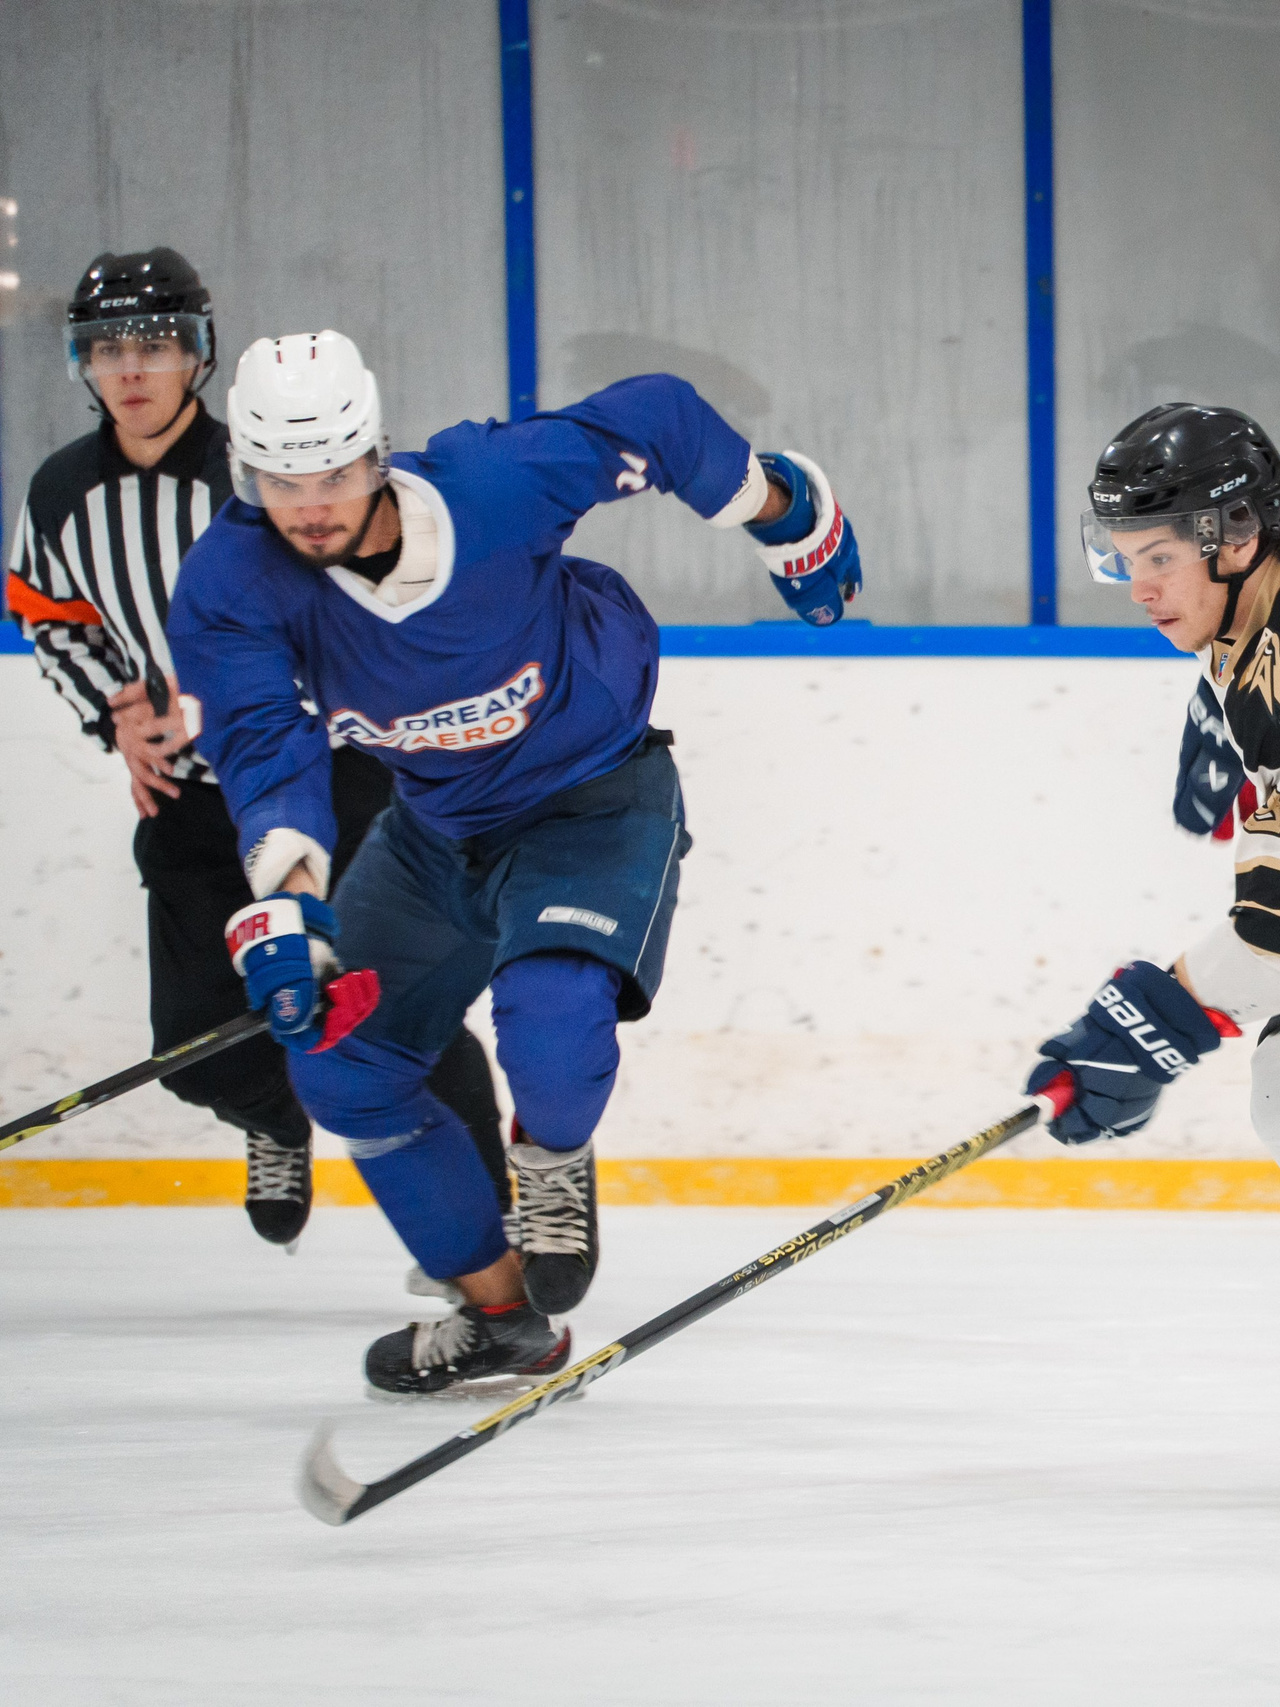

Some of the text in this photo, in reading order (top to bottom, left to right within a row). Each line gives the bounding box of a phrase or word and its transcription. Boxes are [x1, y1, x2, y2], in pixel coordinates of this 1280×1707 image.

[100, 296, 138, 308] CCM
[281, 438, 330, 450] CCM
[1093, 492, 1122, 503] CCM
[1210, 473, 1247, 498] CCM
[404, 675, 532, 732] DREAM
[411, 715, 516, 747] AERO
[760, 1231, 818, 1265] TACKS
[790, 1214, 864, 1264] TACKS
